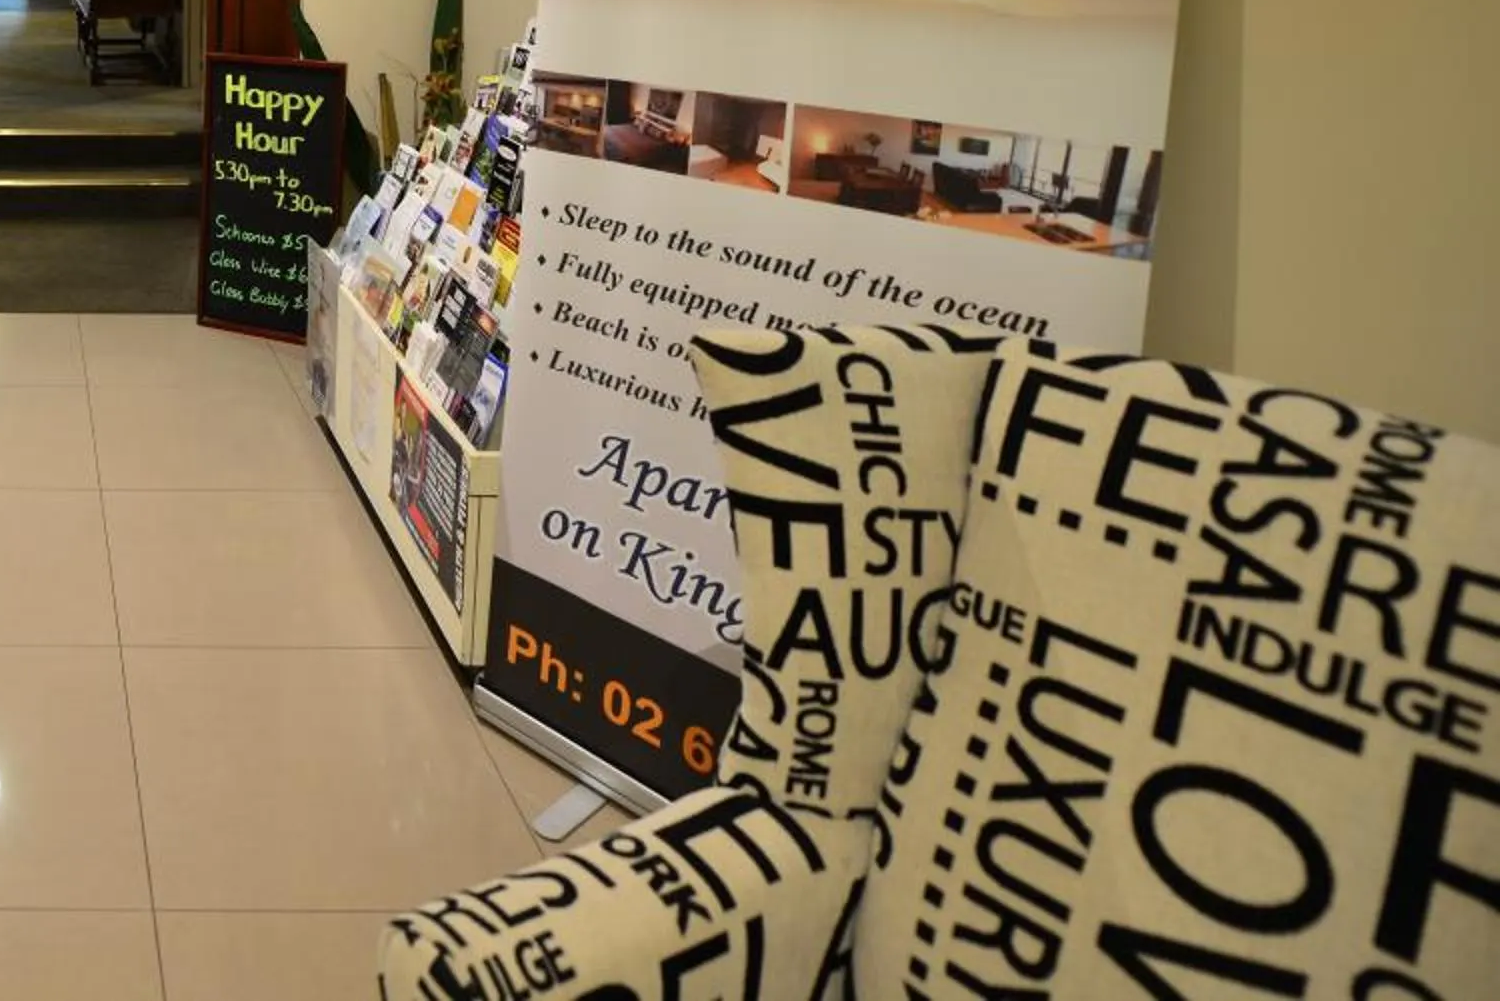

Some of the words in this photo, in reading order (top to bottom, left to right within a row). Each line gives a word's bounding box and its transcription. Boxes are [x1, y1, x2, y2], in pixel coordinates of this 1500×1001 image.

[225, 74, 325, 126] Happy
[235, 122, 305, 156] Hour
[276, 168, 300, 189] to
[556, 252, 624, 292] Fully
[630, 277, 760, 326] equipped
[558, 202, 629, 242] Sleep
[634, 223, 660, 246] to
[667, 229, 714, 258] the
[719, 245, 817, 283] sound
[823, 268, 867, 298] of
[867, 274, 924, 309] the
[933, 295, 1050, 338] ocean
[552, 300, 630, 343] Beach
[636, 326, 660, 352] is
[548, 349, 682, 413] Luxurious
[836, 353, 907, 497] CHIC
[1186, 388, 1361, 604] CASA
[541, 508, 602, 558] on
[507, 623, 584, 703] Ph:
[602, 679, 666, 750] 02
[1175, 598, 1489, 755] INDULGE
